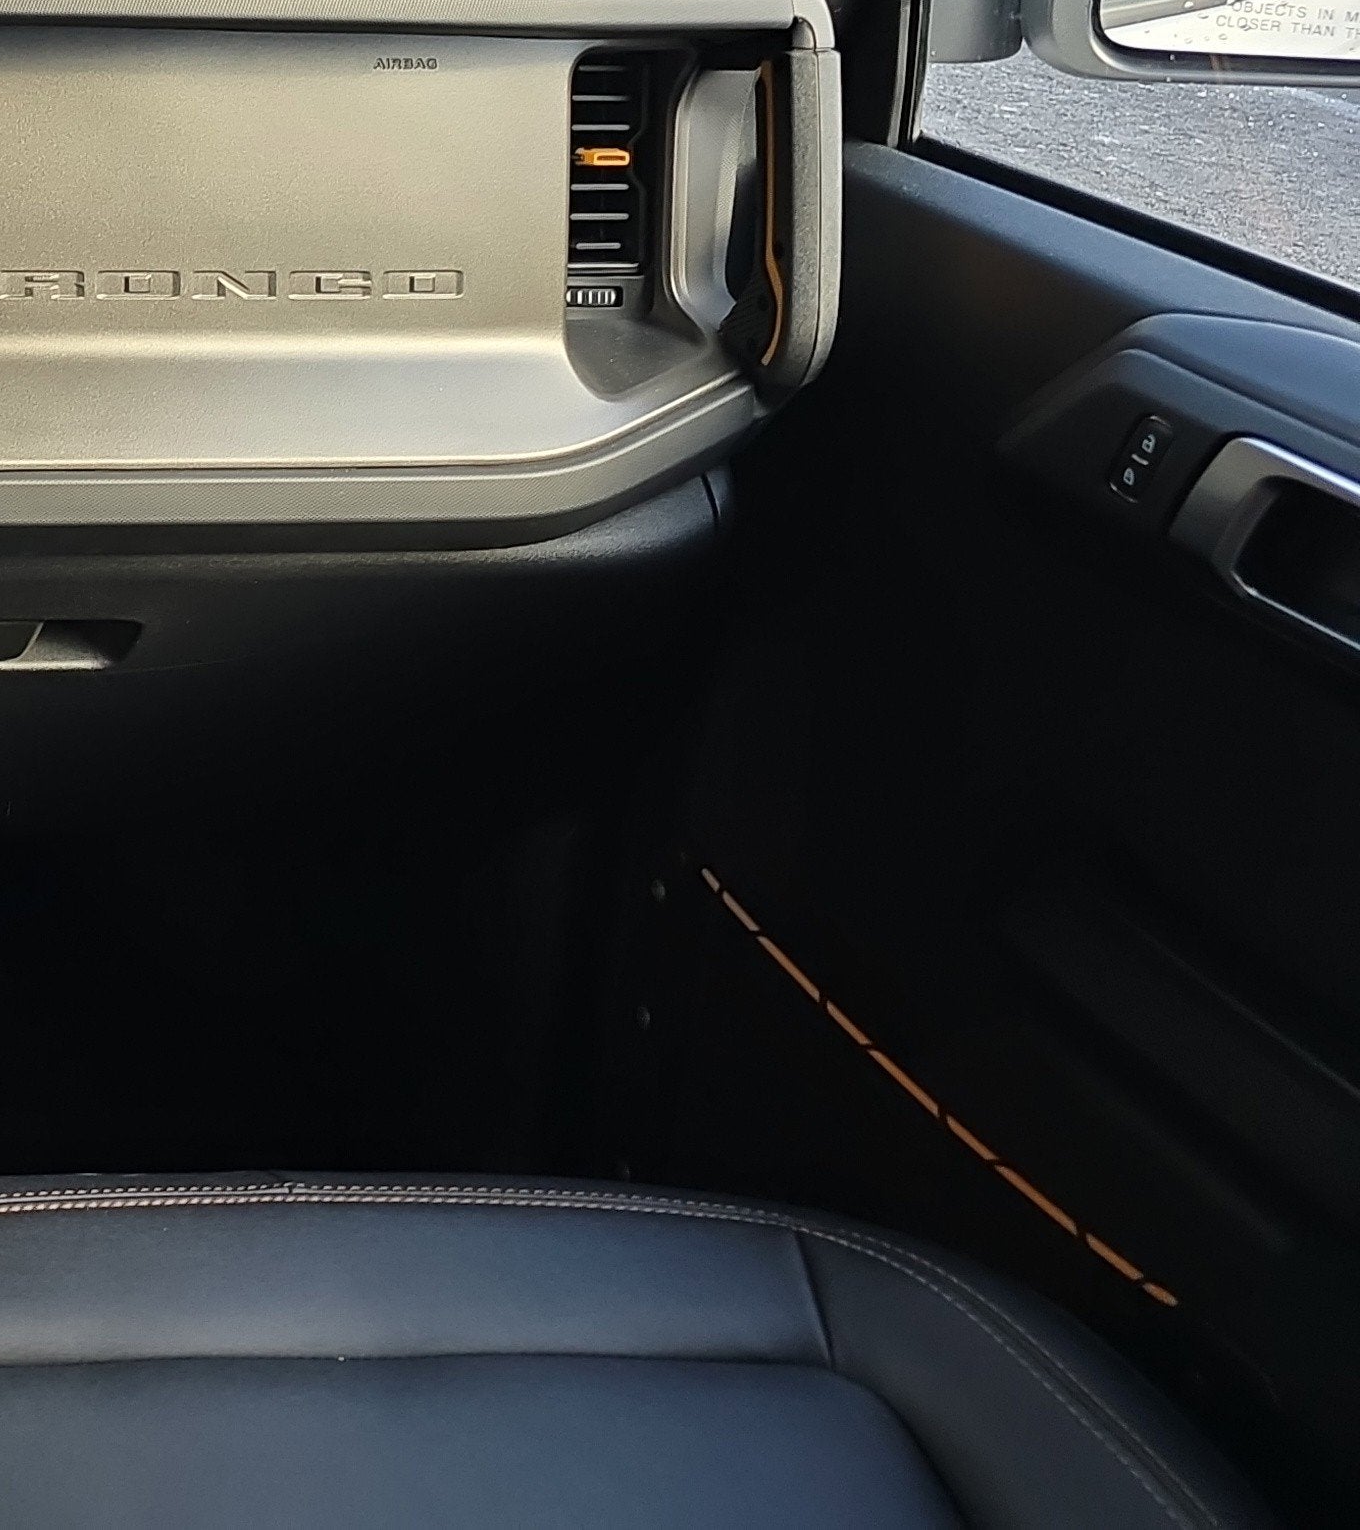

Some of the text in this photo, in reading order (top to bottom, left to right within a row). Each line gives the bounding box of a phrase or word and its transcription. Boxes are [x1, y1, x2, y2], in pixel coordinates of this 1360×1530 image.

[1231, 1, 1308, 19] OBJECTS
[1317, 8, 1334, 20] IN
[1215, 15, 1281, 32] CLOSER
[1290, 22, 1335, 37] THAN
[372, 57, 438, 71] AIRBAG
